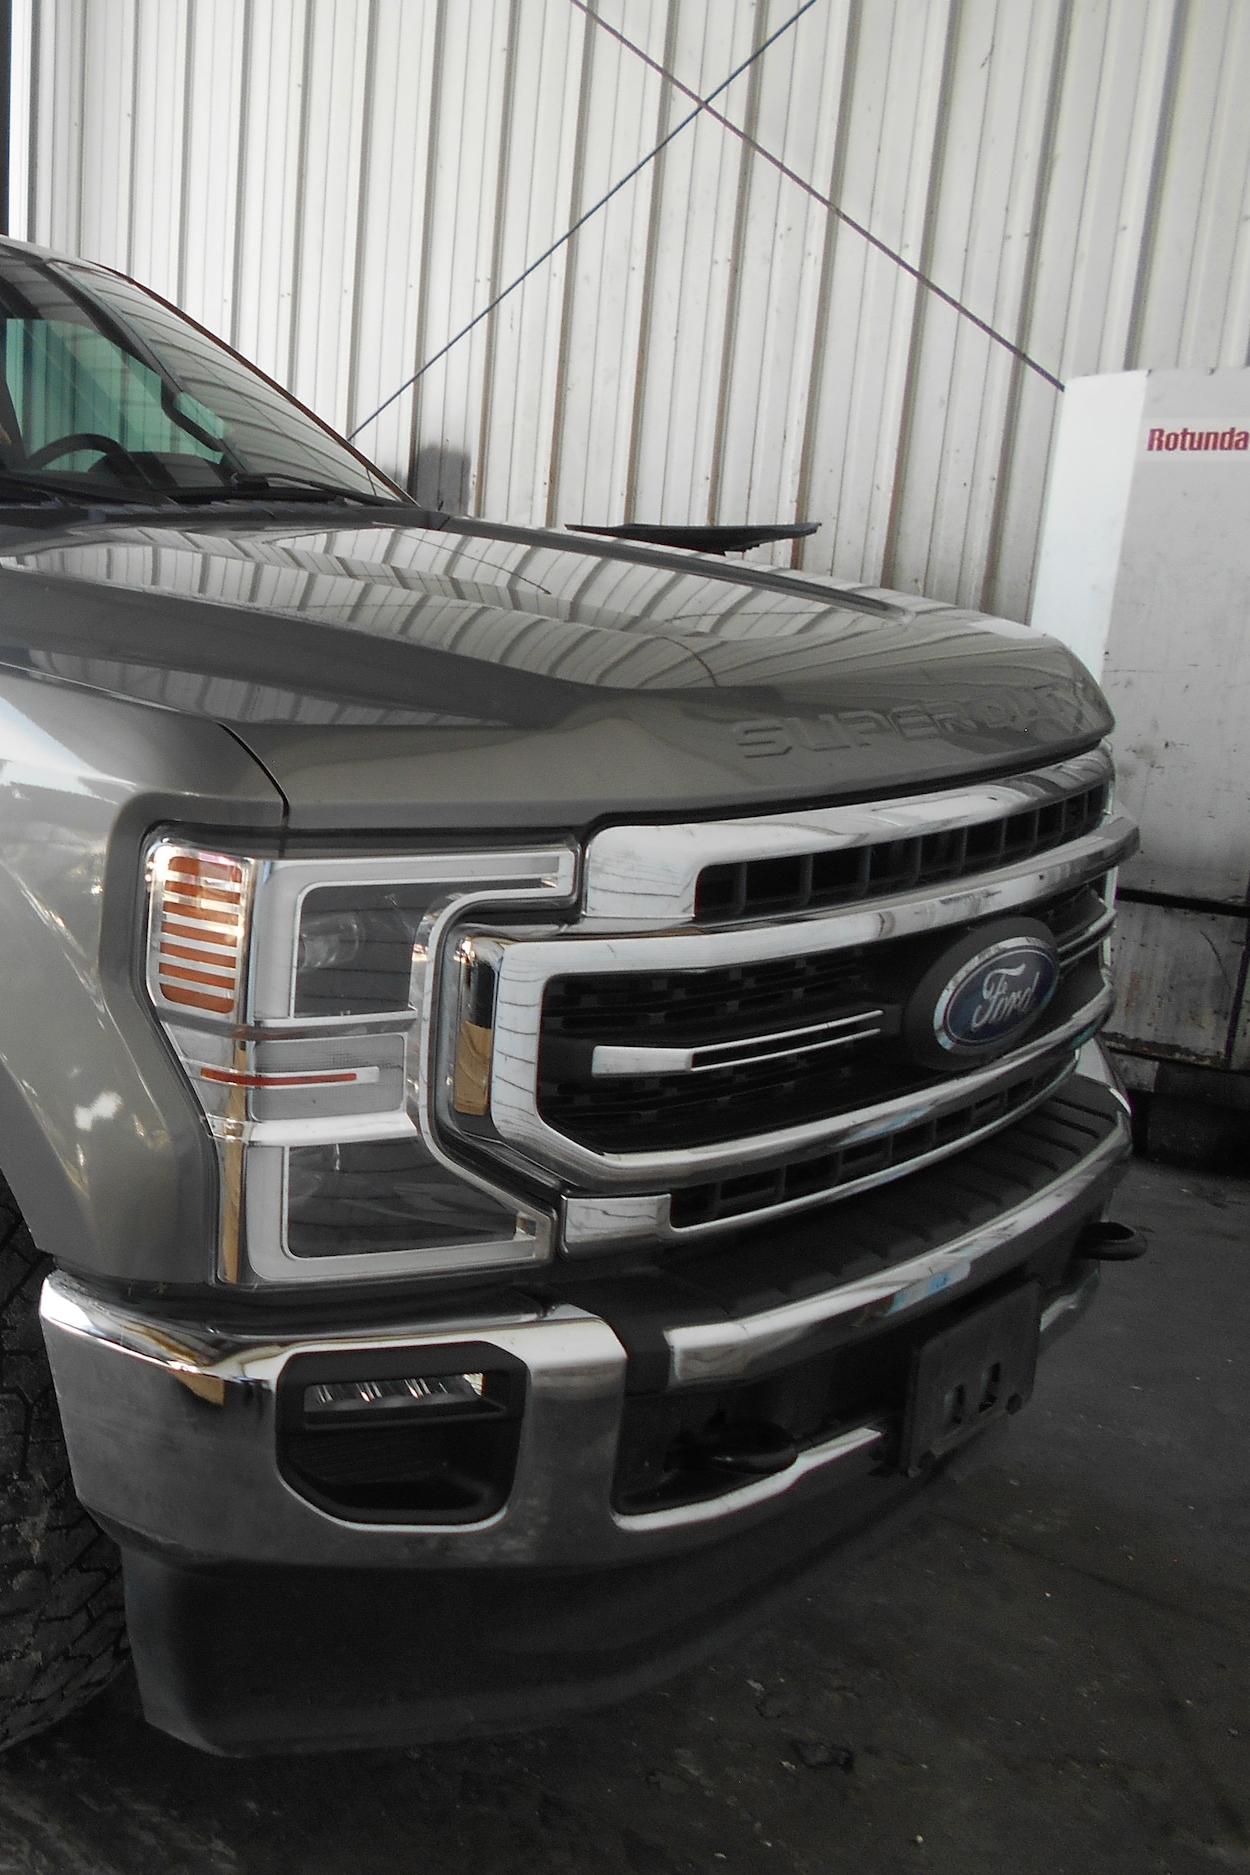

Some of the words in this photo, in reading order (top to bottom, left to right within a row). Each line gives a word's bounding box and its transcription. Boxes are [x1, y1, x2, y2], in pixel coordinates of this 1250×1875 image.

[1147, 427, 1249, 452] Rotunda
[734, 702, 977, 760] SUPER
[970, 962, 1040, 1033] Ford
